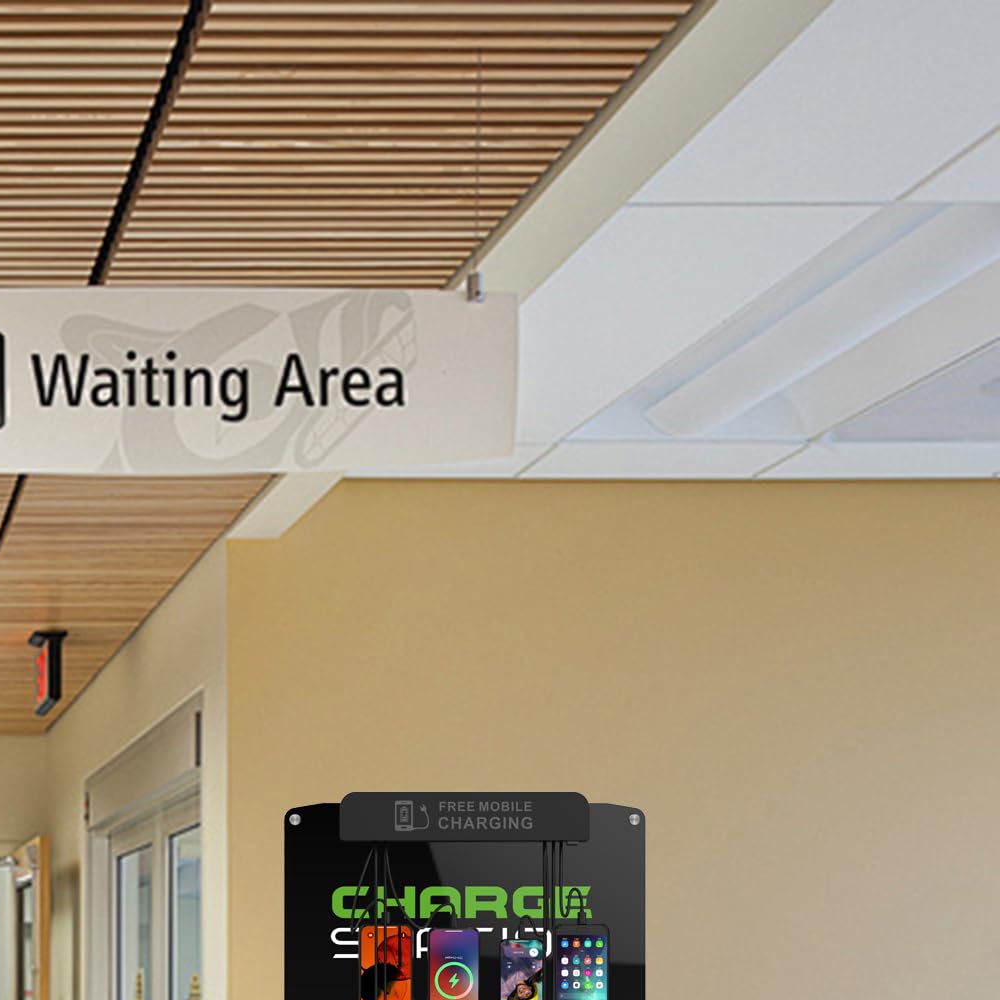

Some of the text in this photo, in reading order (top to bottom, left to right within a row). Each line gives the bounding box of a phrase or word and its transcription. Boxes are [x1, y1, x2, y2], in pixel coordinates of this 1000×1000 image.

[32, 351, 405, 422] Waiting Area
[439, 801, 533, 812] FREE MOBILE
[438, 816, 533, 830] CHARGING
[332, 886, 592, 919] CHARGE
